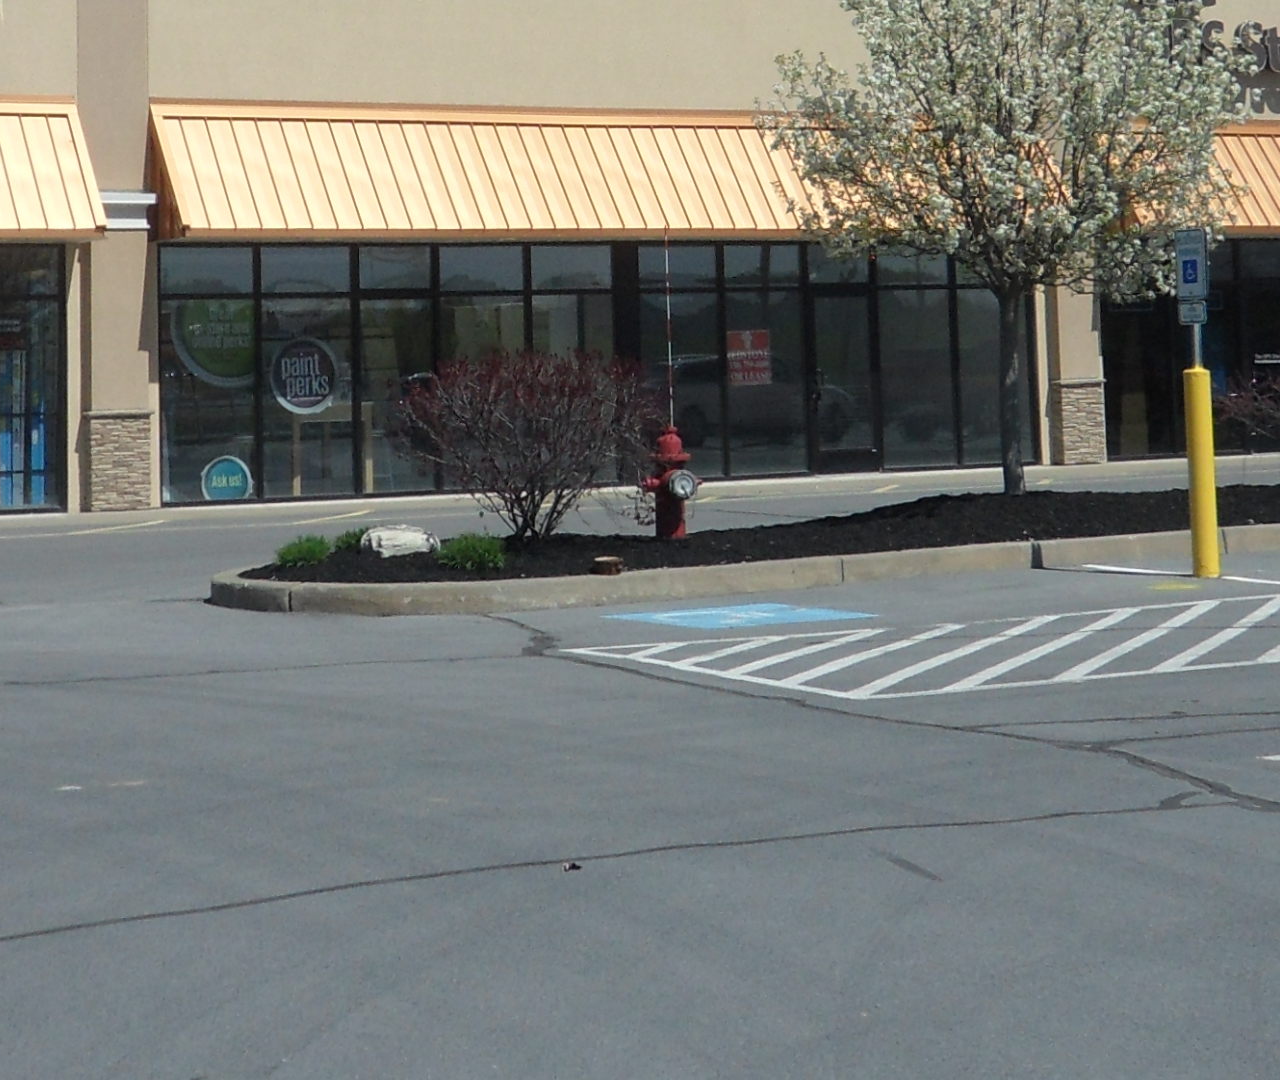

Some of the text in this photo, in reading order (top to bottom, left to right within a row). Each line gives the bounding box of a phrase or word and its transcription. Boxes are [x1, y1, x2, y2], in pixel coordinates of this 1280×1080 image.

[281, 353, 321, 380] paint
[286, 375, 329, 399] perks
[212, 474, 228, 488] Ask
